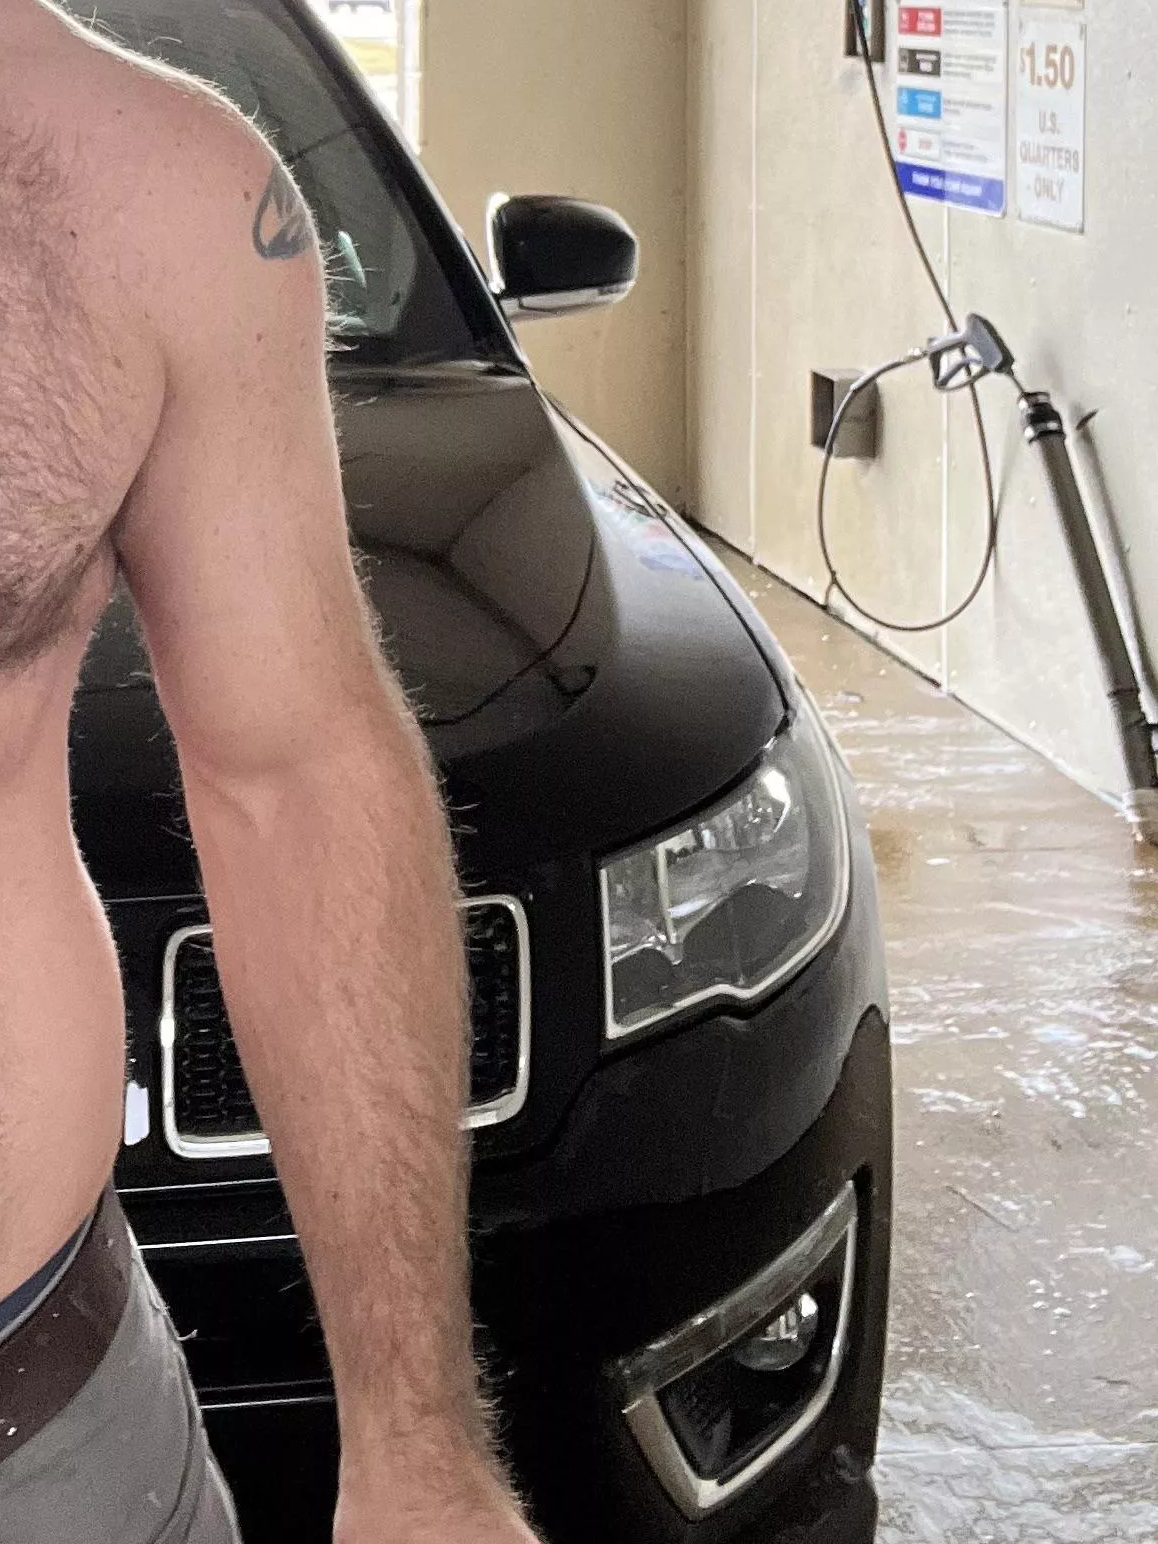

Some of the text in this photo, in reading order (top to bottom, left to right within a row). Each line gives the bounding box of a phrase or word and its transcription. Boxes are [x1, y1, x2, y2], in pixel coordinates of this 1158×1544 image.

[1039, 111, 1060, 134] U.S.
[1020, 141, 1079, 172] QUARTERS
[1034, 176, 1064, 203] ONLY
